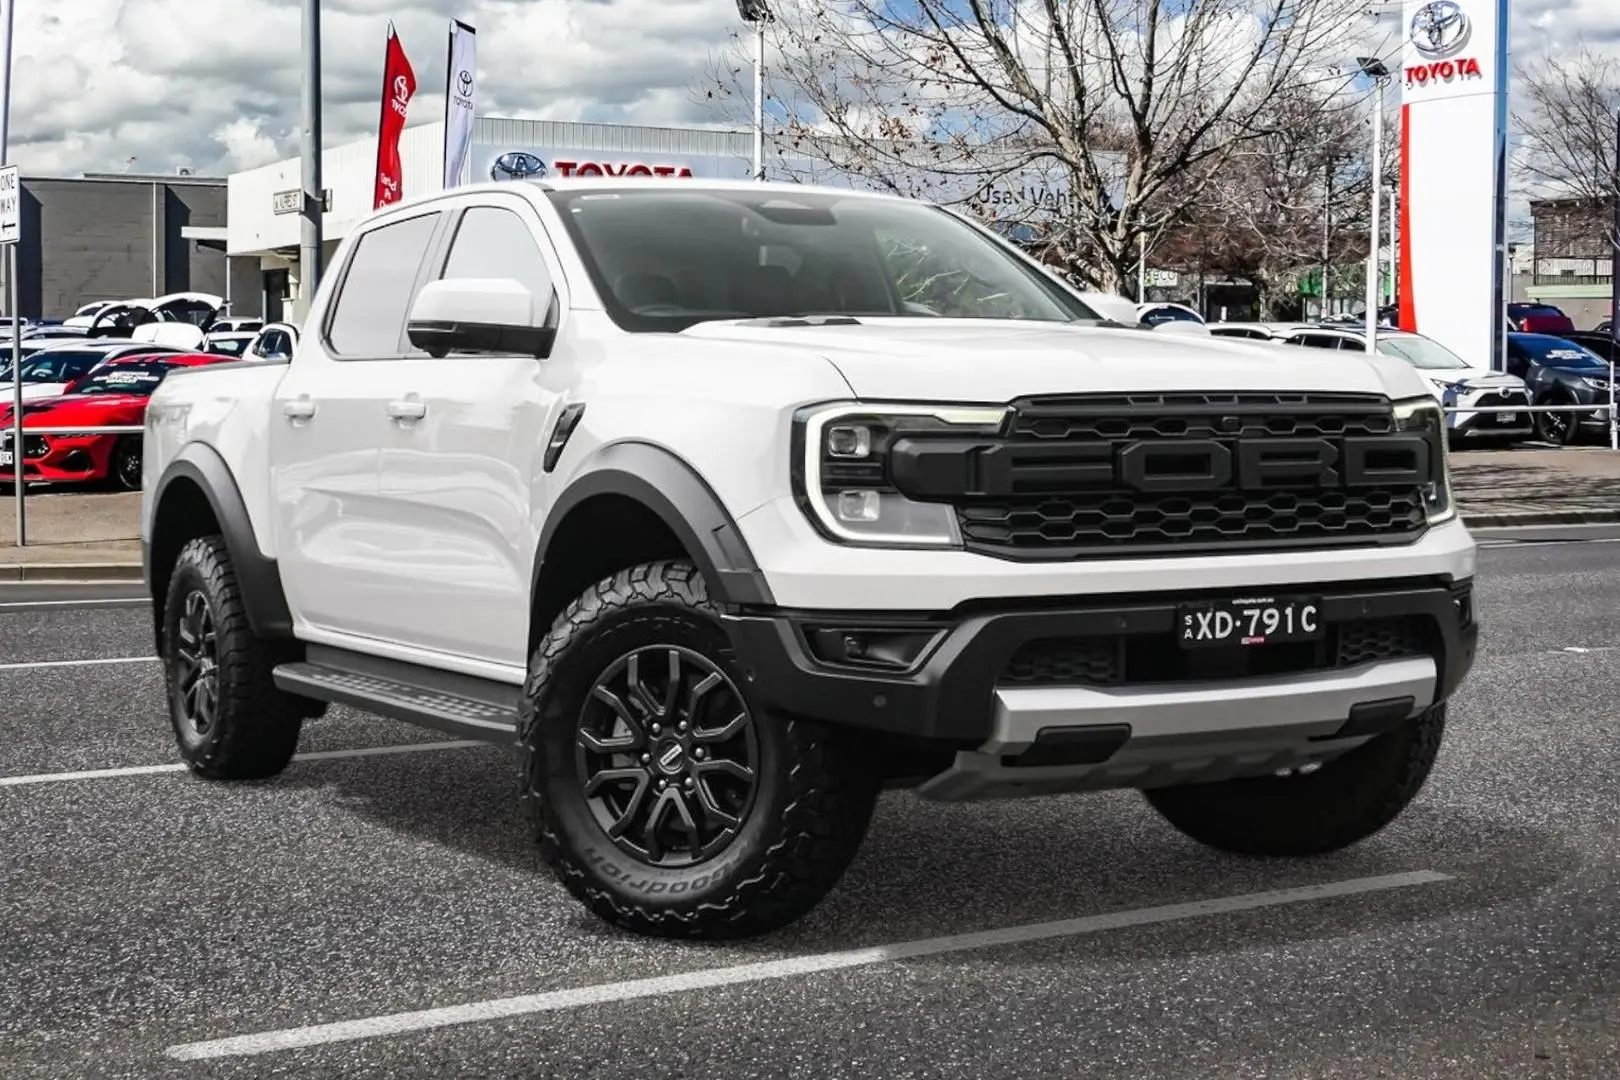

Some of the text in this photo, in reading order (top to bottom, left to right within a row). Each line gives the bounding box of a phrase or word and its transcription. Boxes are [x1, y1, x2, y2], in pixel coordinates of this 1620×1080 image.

[1404, 58, 1481, 83] TOYOTA
[1, 172, 15, 191] ONE
[1, 195, 17, 215] WAY
[980, 436, 1431, 494] FORD
